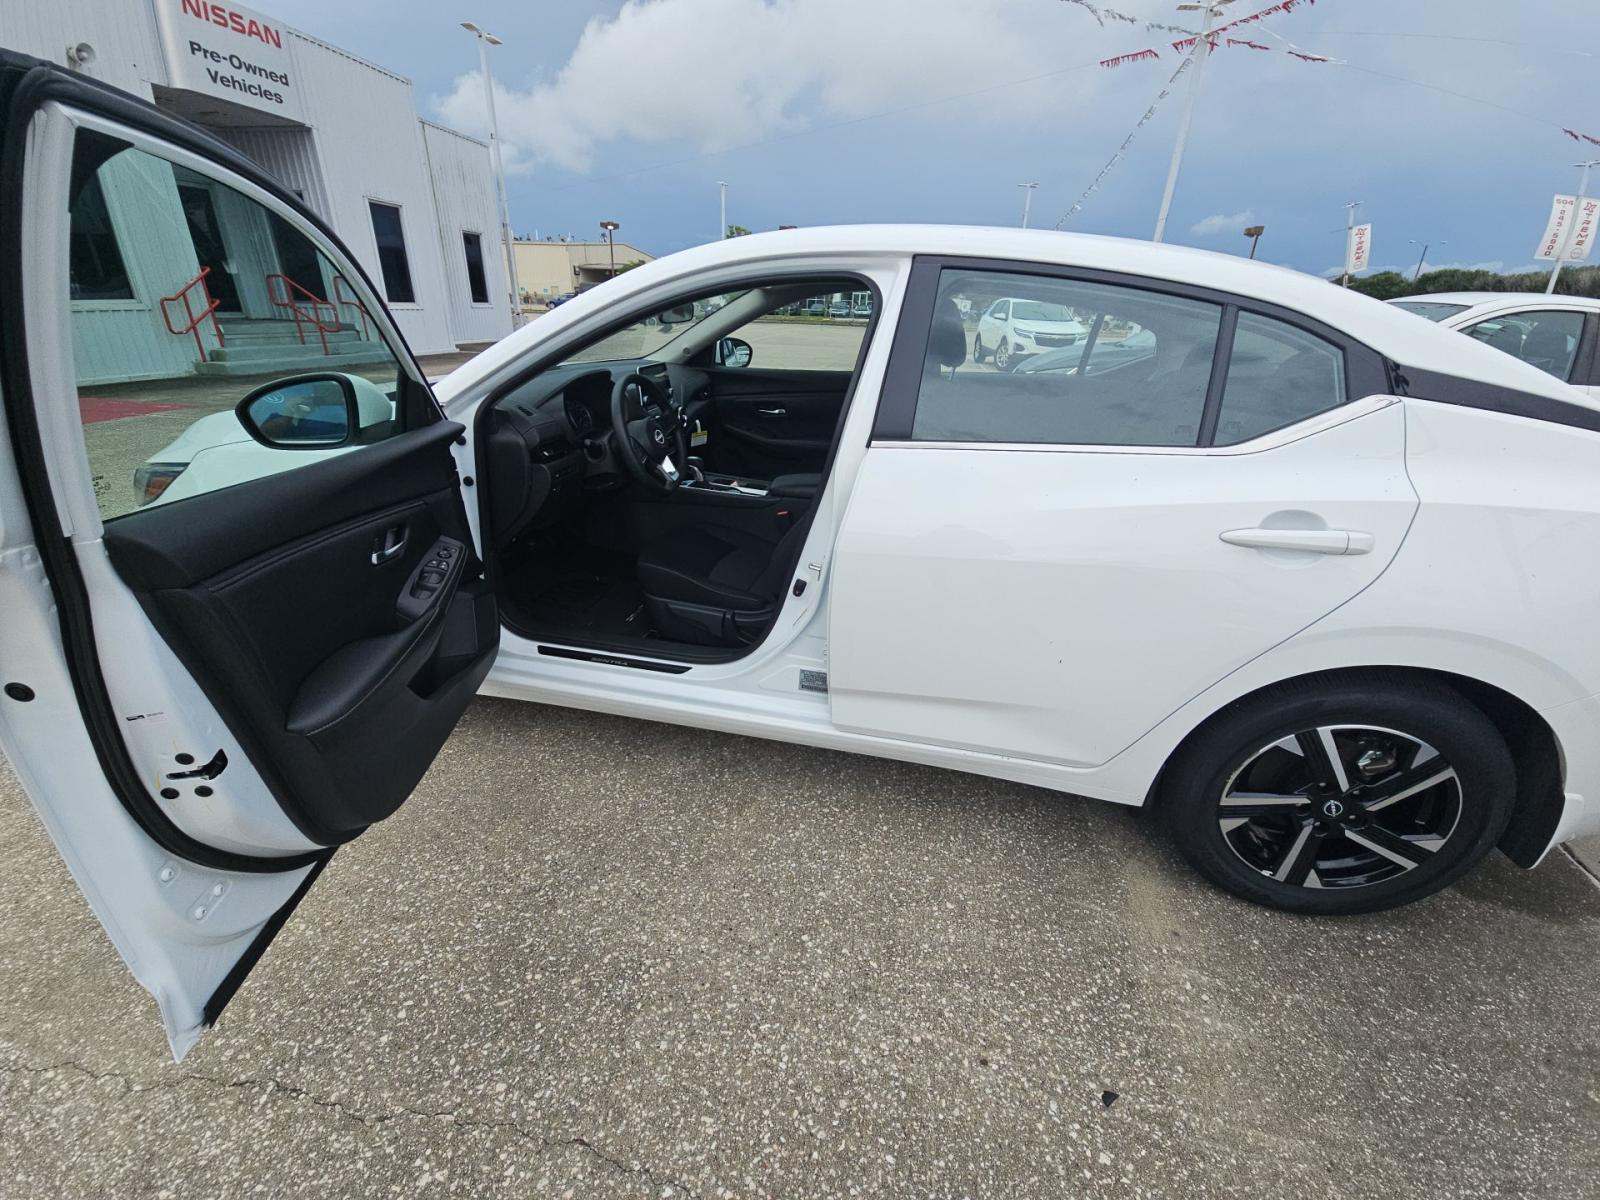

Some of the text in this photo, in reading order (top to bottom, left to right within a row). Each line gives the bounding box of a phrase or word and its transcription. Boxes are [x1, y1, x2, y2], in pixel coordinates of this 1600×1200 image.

[181, 0, 282, 48] NISSAN
[189, 40, 290, 86] Pre-Owned
[206, 67, 284, 104] Vehicles
